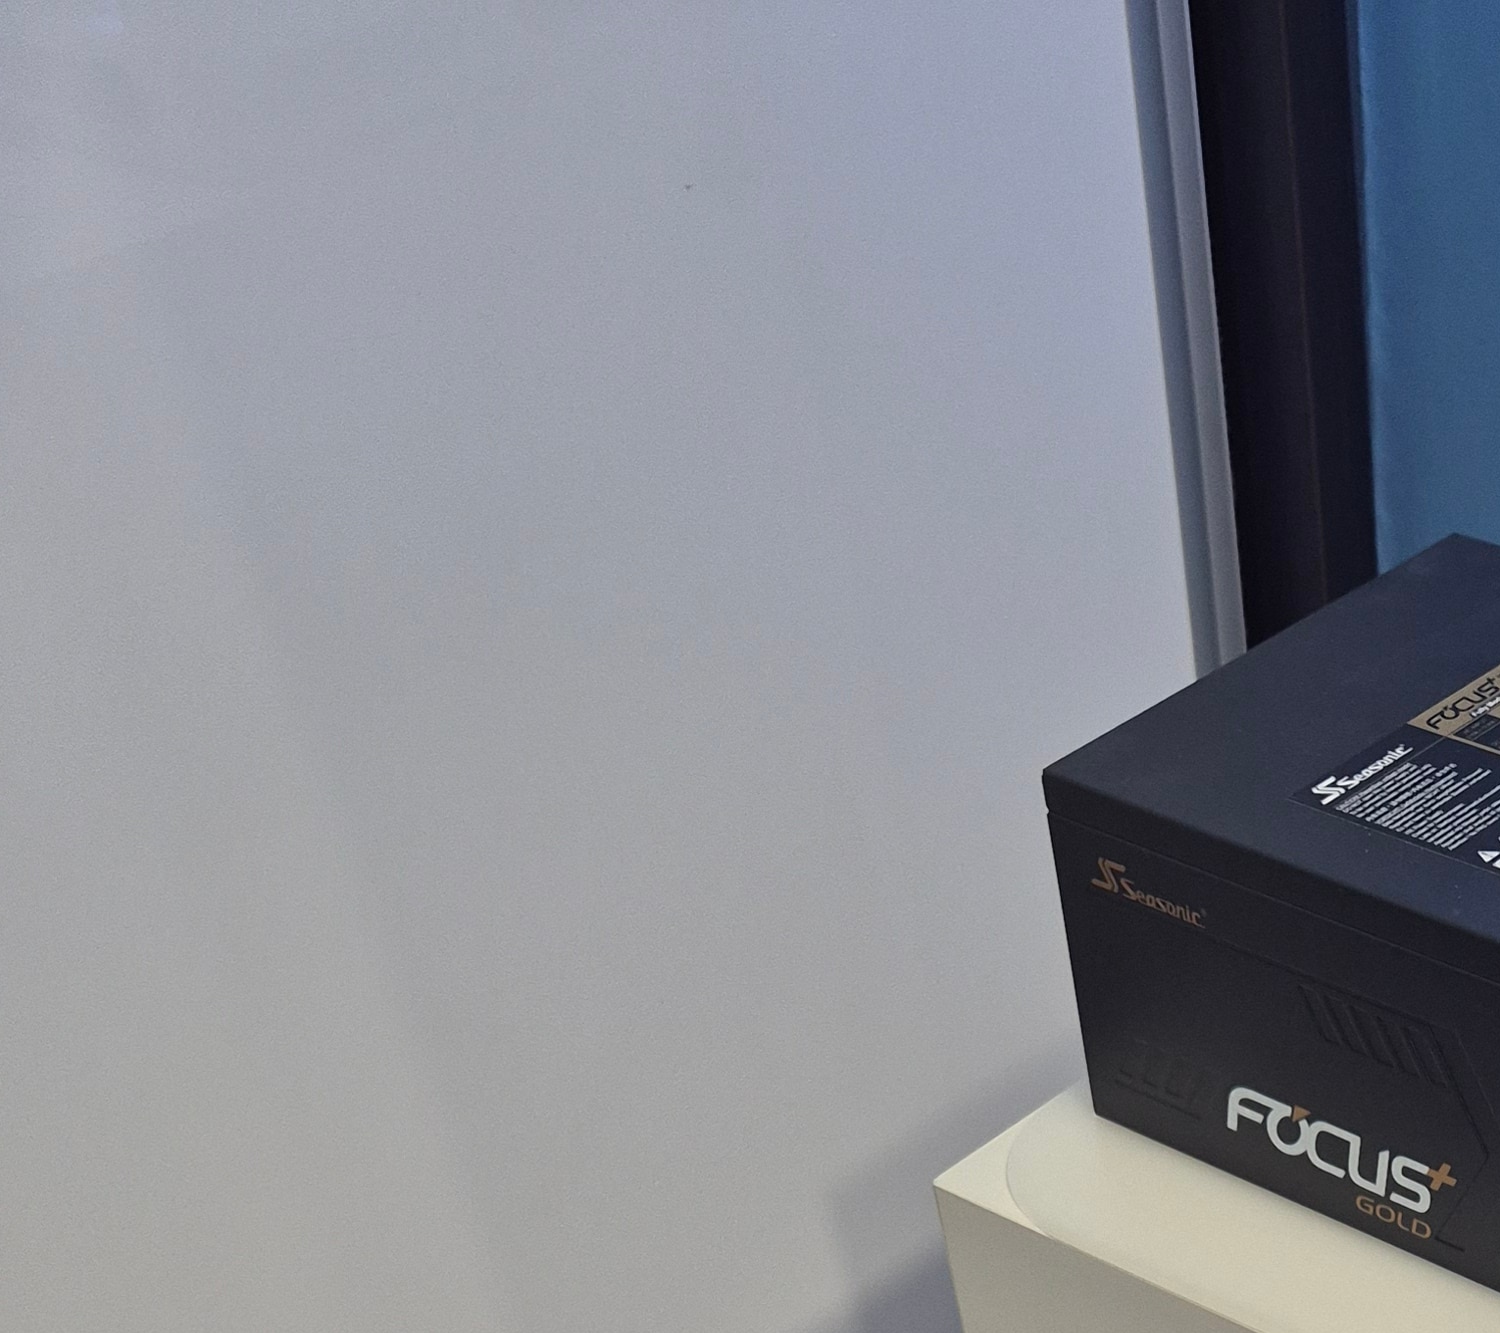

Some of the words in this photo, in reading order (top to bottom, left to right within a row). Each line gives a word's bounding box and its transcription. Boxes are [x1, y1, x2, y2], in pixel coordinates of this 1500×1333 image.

[1346, 744, 1413, 789] Seasonic
[1120, 878, 1206, 928] Seasonic
[1356, 1195, 1432, 1239] GOLD
